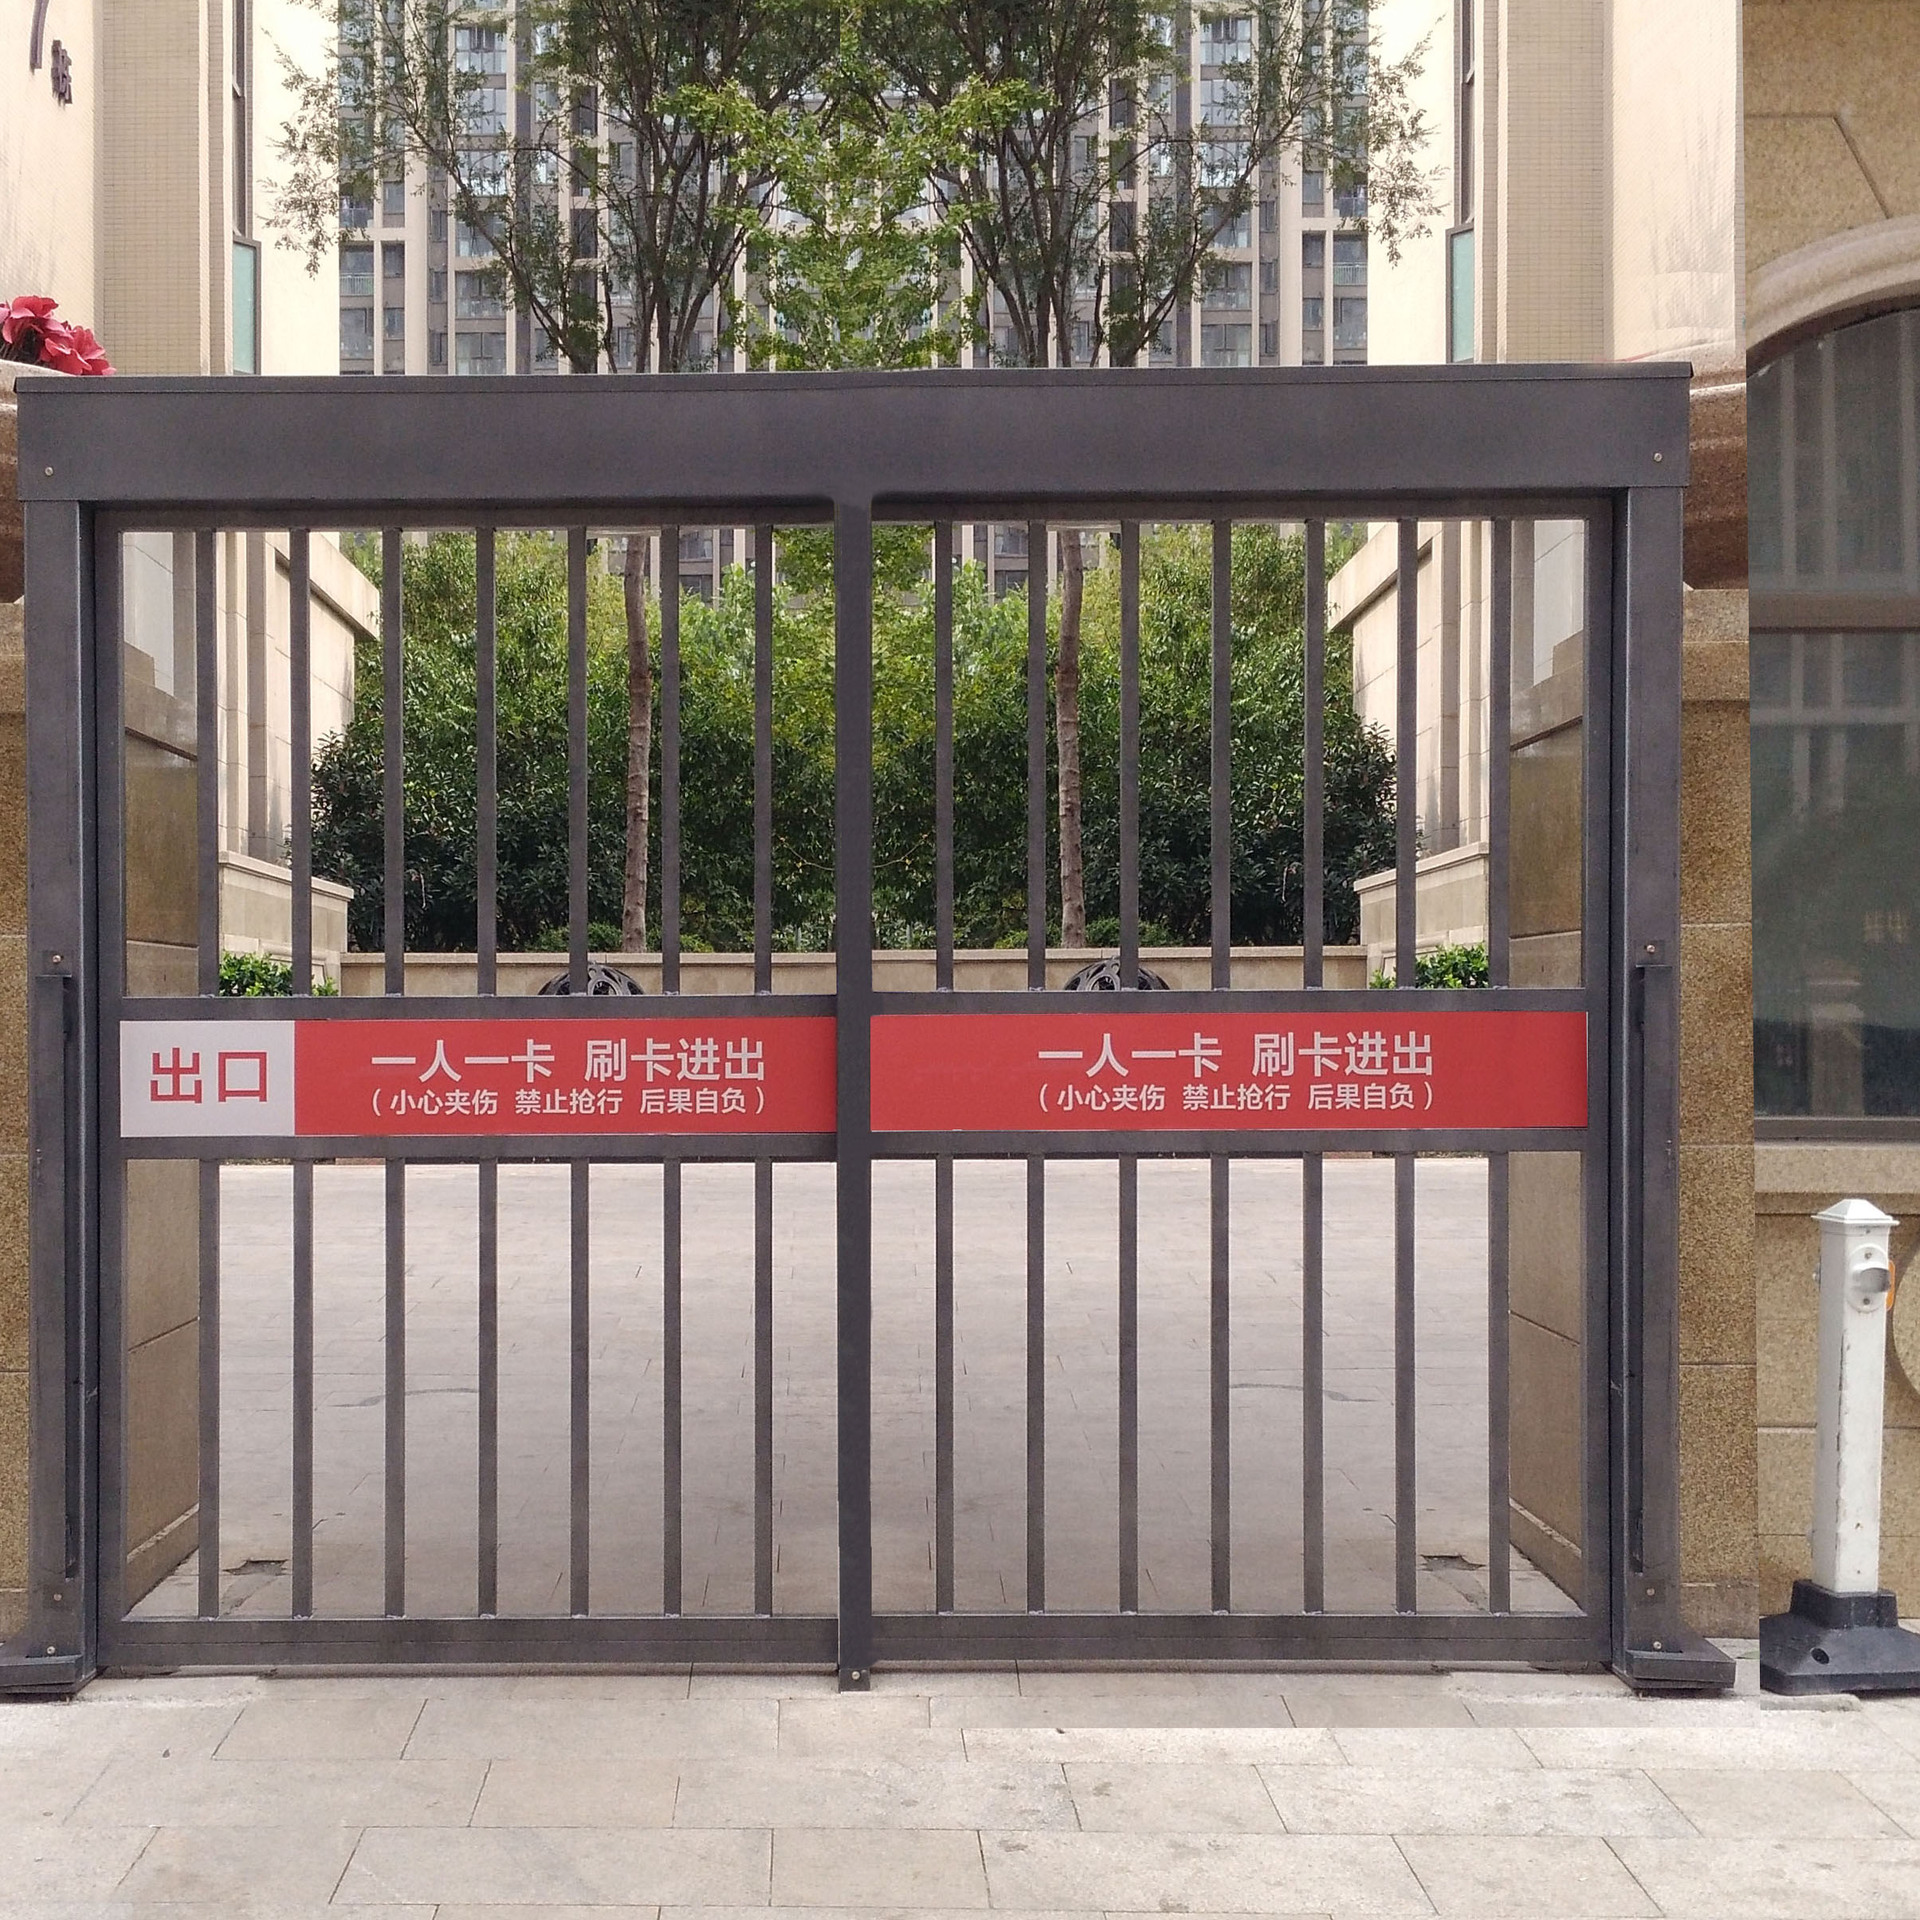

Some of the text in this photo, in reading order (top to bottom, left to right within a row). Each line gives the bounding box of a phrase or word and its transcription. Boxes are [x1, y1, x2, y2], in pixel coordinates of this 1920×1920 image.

[150, 1047, 268, 1104] 出口
[371, 1038, 764, 1083] 一人一卡 刷卡进出
[1038, 1031, 1432, 1077] 一人一卡 刷卡进出
[515, 1087, 623, 1115] 禁止抢行
[1182, 1082, 1291, 1111] 禁止抢行
